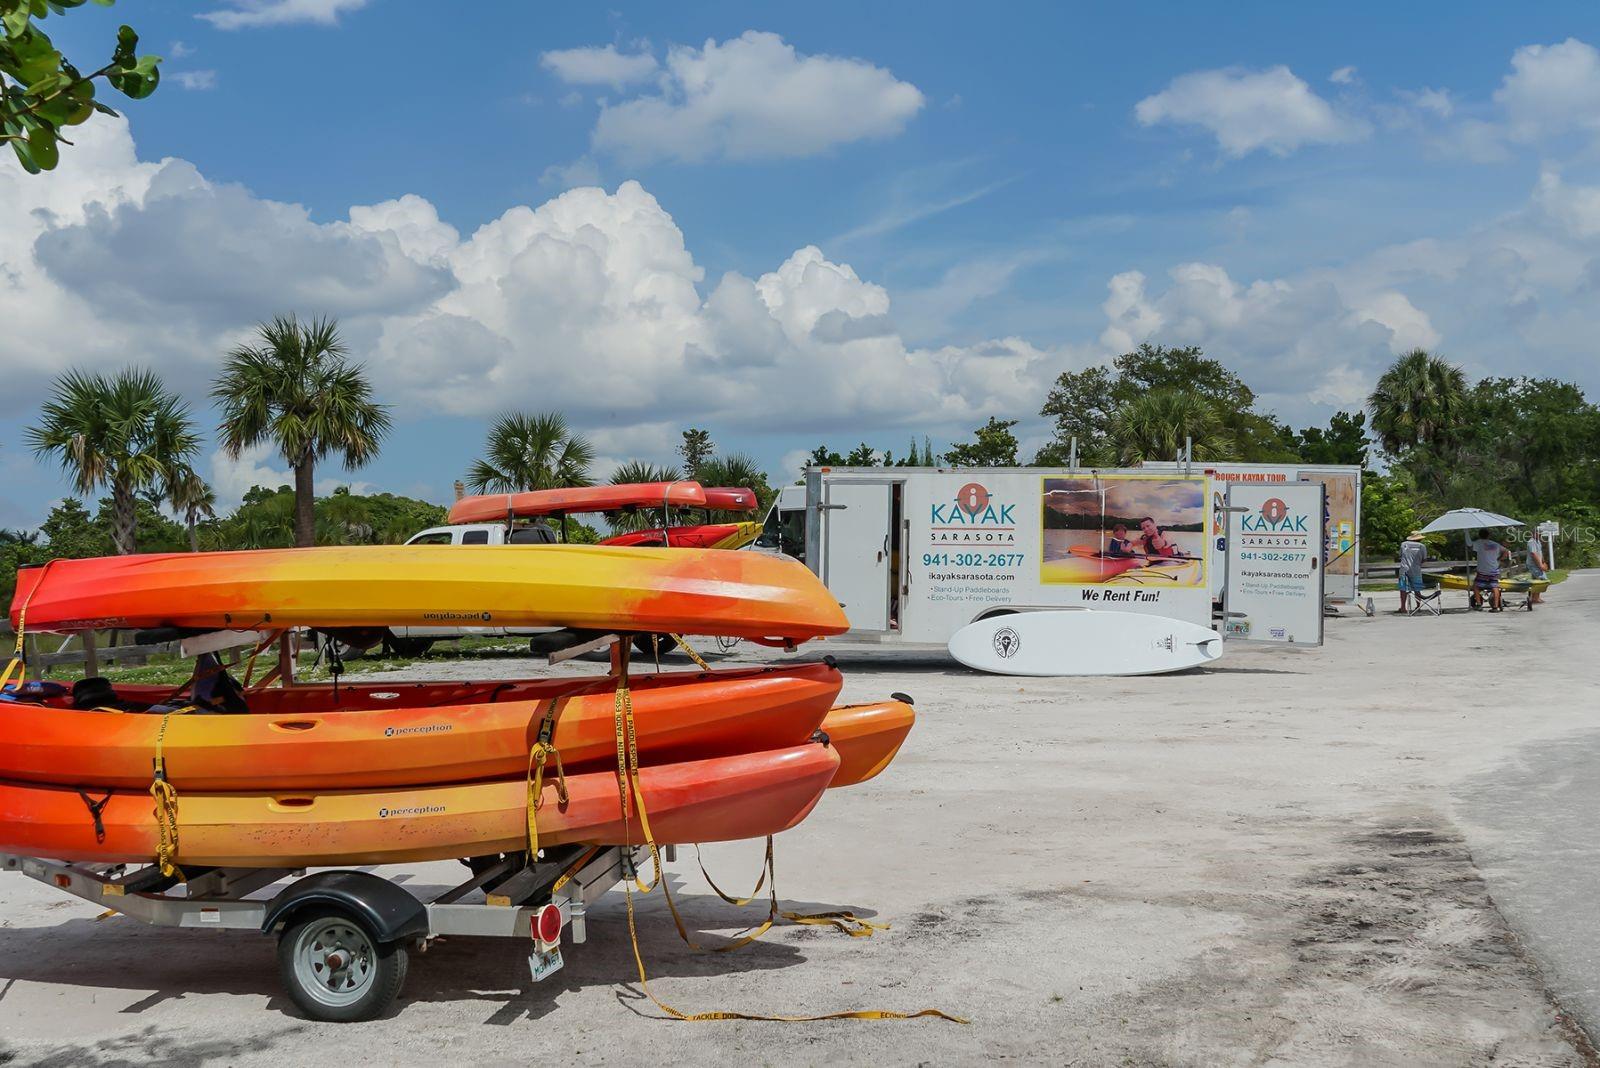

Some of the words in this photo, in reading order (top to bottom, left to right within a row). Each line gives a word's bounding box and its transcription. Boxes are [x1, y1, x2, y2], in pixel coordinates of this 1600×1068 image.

[1242, 473, 1264, 482] KAYAK
[1267, 474, 1286, 482] TOUR
[931, 503, 1016, 525] KAYAK
[1241, 514, 1308, 532] KAYAK
[931, 533, 1014, 541] SARASOTA
[1241, 538, 1307, 546] SARASOTA
[922, 553, 1025, 567] 941-302-2677
[1240, 552, 1306, 561] 941-302-2677
[928, 572, 1015, 582] ikayaksarasota.com
[1241, 570, 1309, 579] ikayaksarasota.com
[965, 586, 1010, 594] Paddleboards
[985, 595, 1012, 603] Delivery
[1082, 589, 1099, 601] We
[1103, 590, 1130, 602] Rent
[1134, 591, 1160, 602] Fun!
[423, 611, 480, 620] perception
[396, 724, 453, 736] perception
[390, 805, 446, 817] perception
